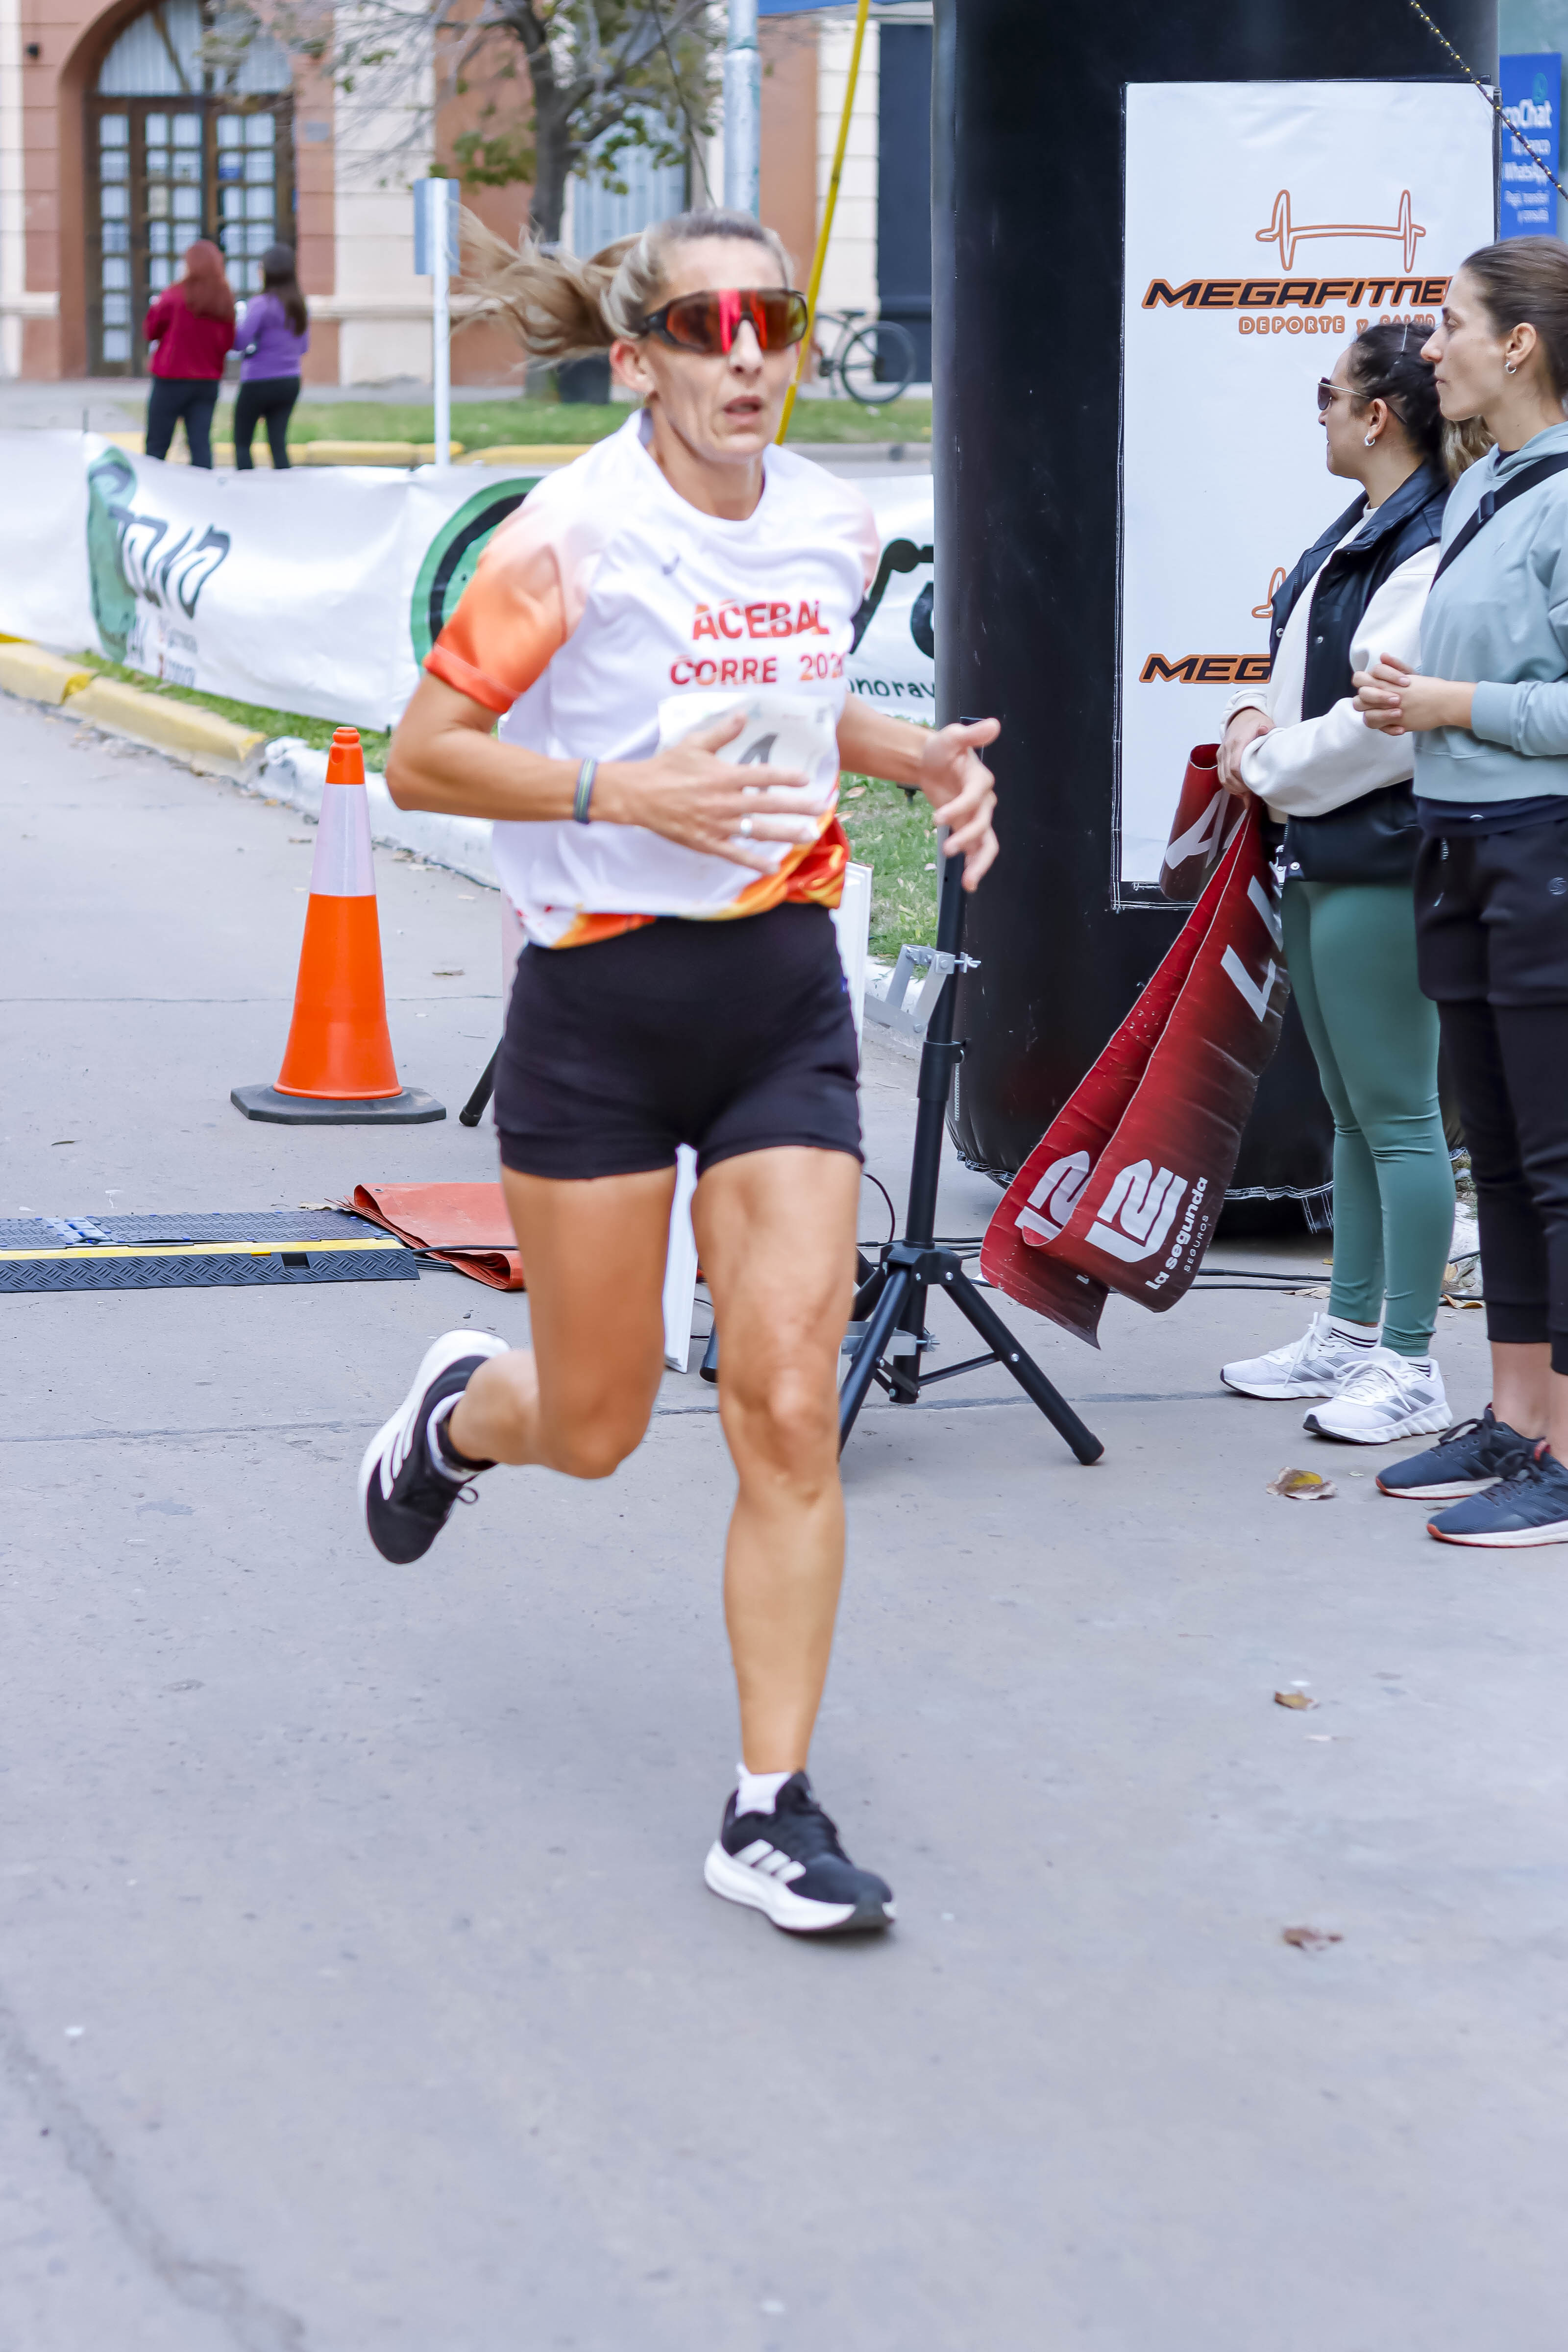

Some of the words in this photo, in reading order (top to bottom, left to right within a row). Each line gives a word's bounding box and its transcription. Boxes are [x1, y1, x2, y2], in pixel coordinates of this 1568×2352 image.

[1143, 277, 1450, 308] MEGAFITNE
[1240, 317, 1344, 333] DEPORTE
[692, 600, 830, 640] ACEBAL
[670, 656, 777, 685] CORRE
[1140, 654, 1270, 684] MEG
[1145, 1271, 1170, 1290] la
[1165, 1176, 1208, 1270] segunda
[1183, 1215, 1209, 1273] SEGUROS
